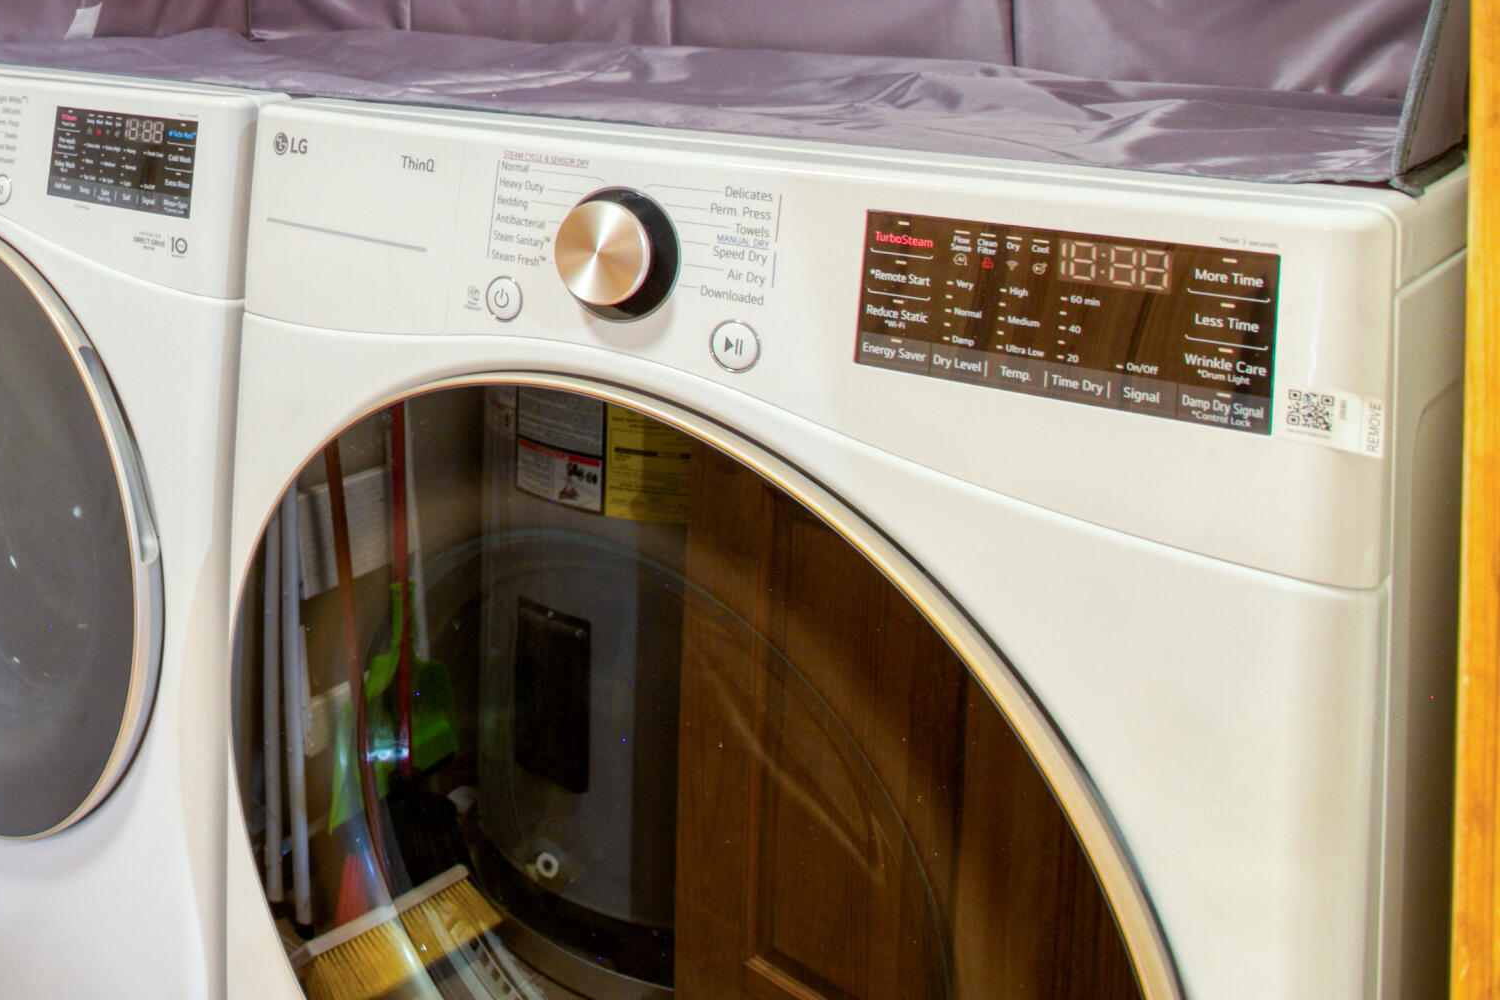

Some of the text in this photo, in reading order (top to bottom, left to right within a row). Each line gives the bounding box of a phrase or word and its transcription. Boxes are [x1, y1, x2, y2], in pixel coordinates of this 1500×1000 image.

[290, 137, 308, 154] LG
[401, 155, 435, 172] ThinQ
[504, 149, 589, 167] STEAM CYCLE & SENSOR DRY
[501, 161, 530, 173] Normal
[500, 178, 545, 194] Heavy Duty
[725, 186, 774, 202] Delicates
[497, 194, 528, 211] Bedding
[710, 202, 772, 221] Perm. Press
[496, 213, 546, 230] Antibacterial
[493, 230, 514, 242] Steam
[735, 223, 771, 238] Towels
[171, 236, 188, 254] 10
[717, 234, 770, 249] MANUAL DRY
[875, 231, 934, 248] TurboSteam
[953, 235, 971, 244] Flow
[977, 238, 998, 248] Clean
[1006, 241, 1020, 252] Dry
[713, 245, 768, 266] Speed Dry
[951, 243, 972, 253] Sense
[977, 246, 997, 255] Filter
[1031, 244, 1050, 254] Cool
[491, 250, 515, 262] Steam
[727, 269, 766, 287] Air Dry
[908, 273, 931, 287] Start
[955, 279, 974, 291] Very
[1194, 268, 1264, 288] More Time
[700, 285, 764, 306] Downloaded
[1009, 286, 1028, 297] High
[1070, 295, 1100, 307] 60 min
[866, 304, 928, 324] Reduce Static
[953, 308, 982, 319] Normal
[1007, 316, 1040, 328] Medium
[1068, 325, 1082, 334] 40
[1194, 313, 1260, 333] Less Time
[952, 335, 975, 347] Damp
[862, 342, 927, 362] Energy Saver
[1005, 343, 1045, 358] Ultra Low
[1066, 353, 1079, 363] 20
[932, 354, 981, 372] Dry Level
[1126, 362, 1159, 376] On/Off
[1184, 353, 1267, 377] Wrinkle Care
[1000, 365, 1032, 383] Temp.
[1227, 372, 1251, 386] Light
[1052, 375, 1103, 396] Time Dry
[1123, 386, 1160, 403] Signal
[1182, 395, 1264, 420] Damp Dry Signal
[1230, 415, 1251, 428] Lock
[1366, 401, 1381, 453] REMOVE
